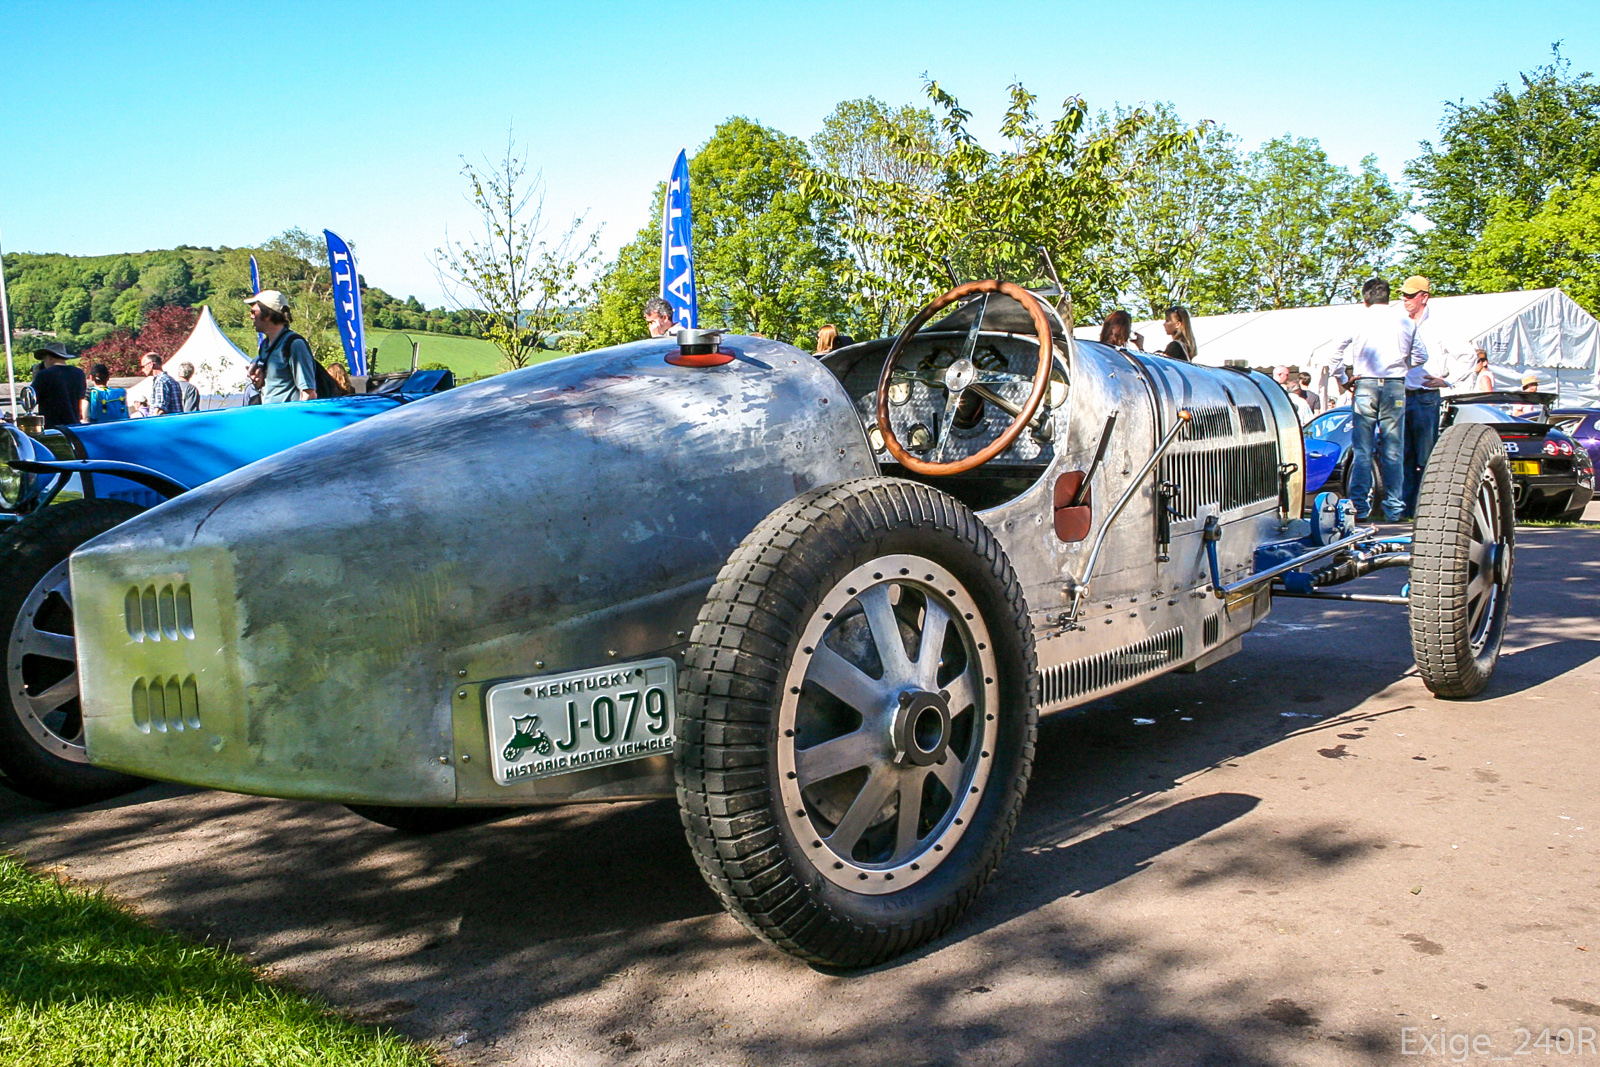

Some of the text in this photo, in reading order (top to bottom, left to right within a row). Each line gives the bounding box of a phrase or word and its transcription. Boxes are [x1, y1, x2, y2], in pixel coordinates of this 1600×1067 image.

[534, 671, 632, 698] KENTUCKY
[554, 686, 667, 750] J-079
[504, 736, 673, 779] HISTORIC MOTOR VEHICLE
